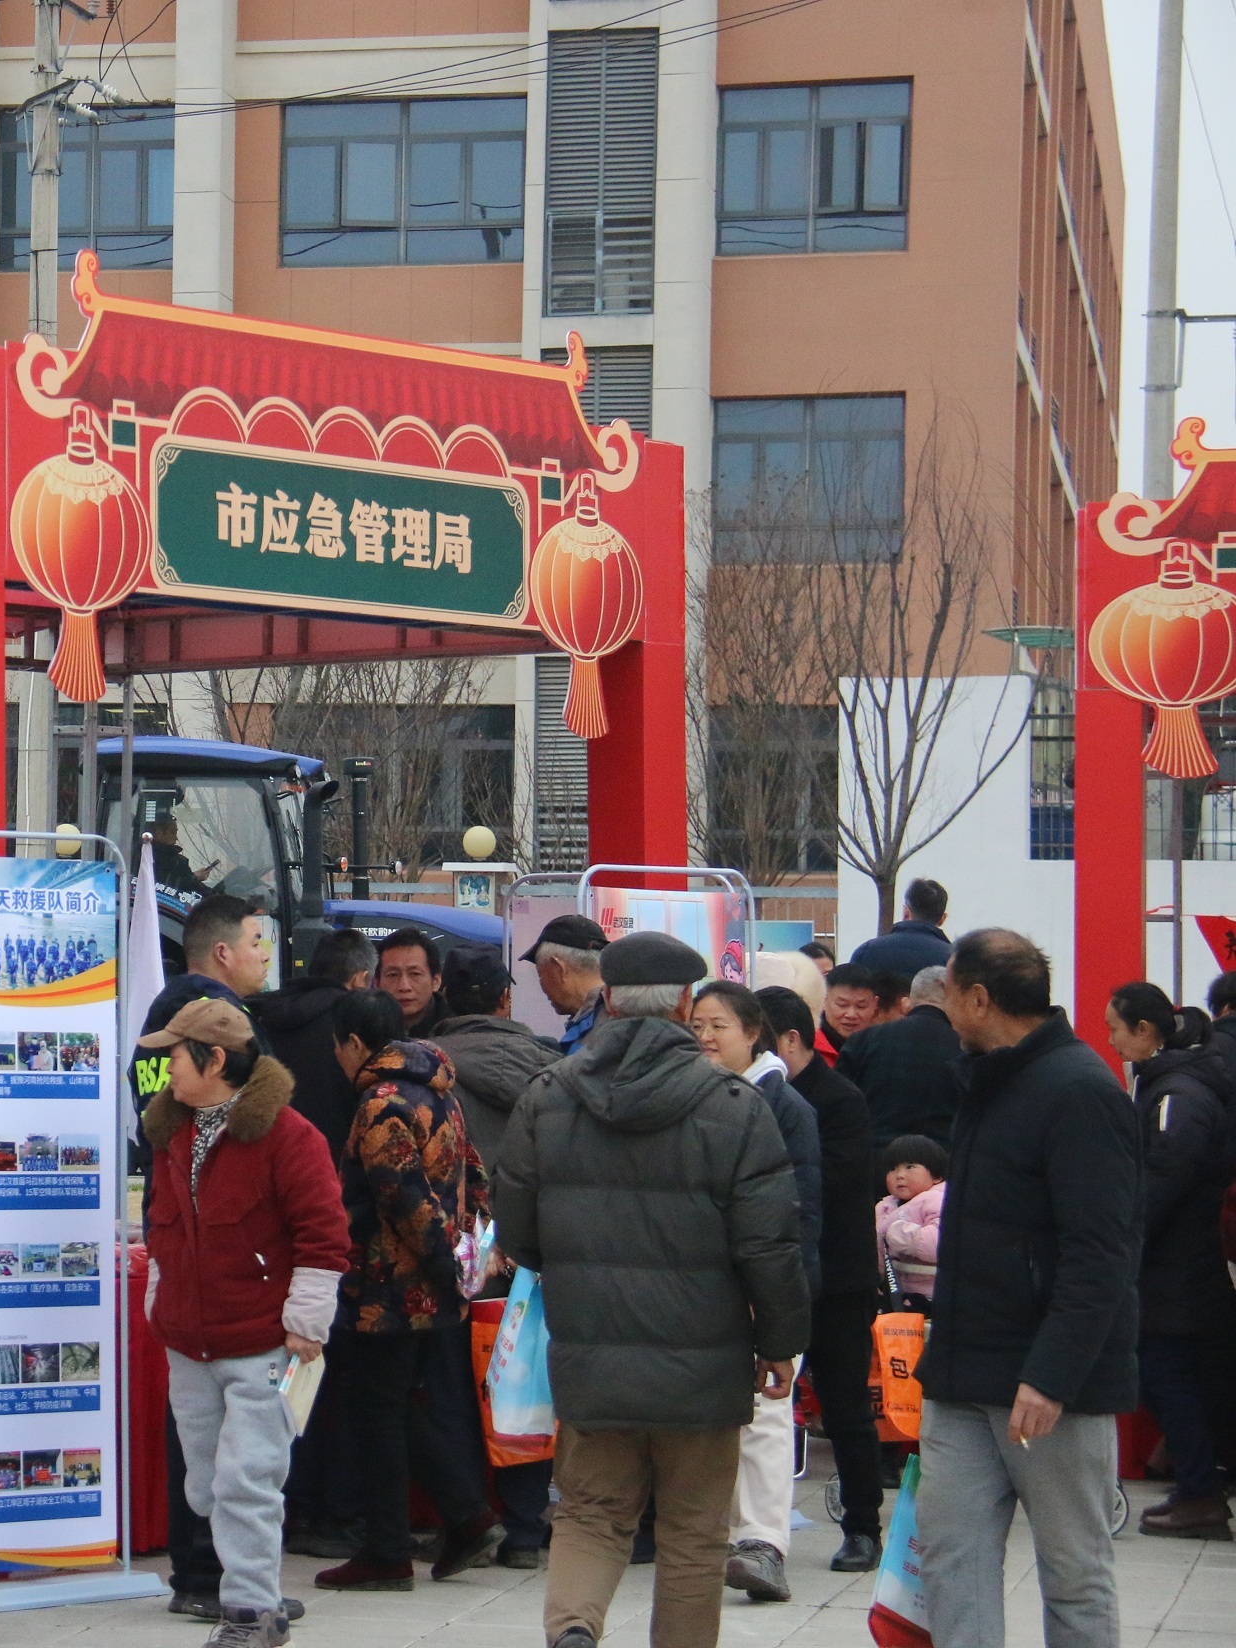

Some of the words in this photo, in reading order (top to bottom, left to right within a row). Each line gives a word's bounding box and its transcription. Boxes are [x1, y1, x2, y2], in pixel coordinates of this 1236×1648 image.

[215, 481, 473, 574] 市应急管理局
